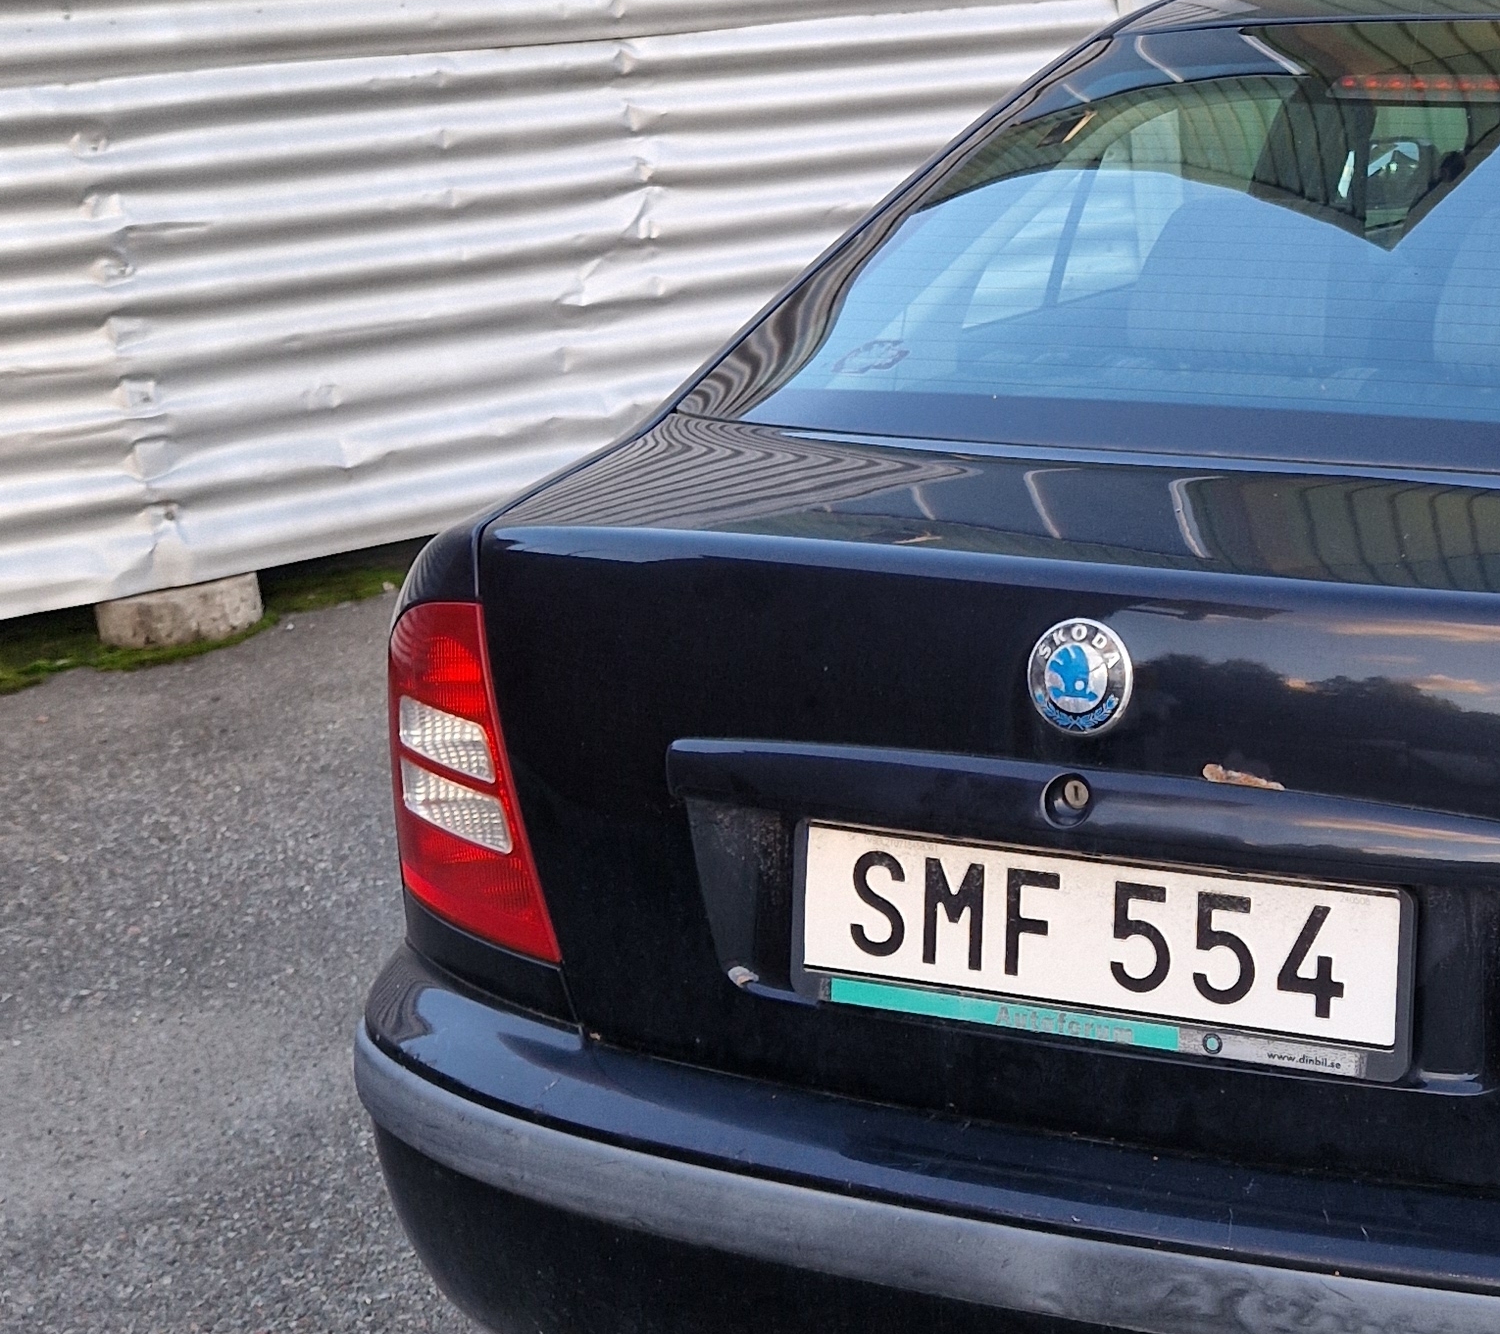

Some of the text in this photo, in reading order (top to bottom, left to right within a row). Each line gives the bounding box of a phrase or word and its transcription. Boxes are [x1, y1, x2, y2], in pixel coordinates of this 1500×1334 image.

[850, 851, 1345, 1019] SMF 554
[995, 1005, 1134, 1044] Autoforum
[1266, 1052, 1342, 1070] www.dinbil.se
